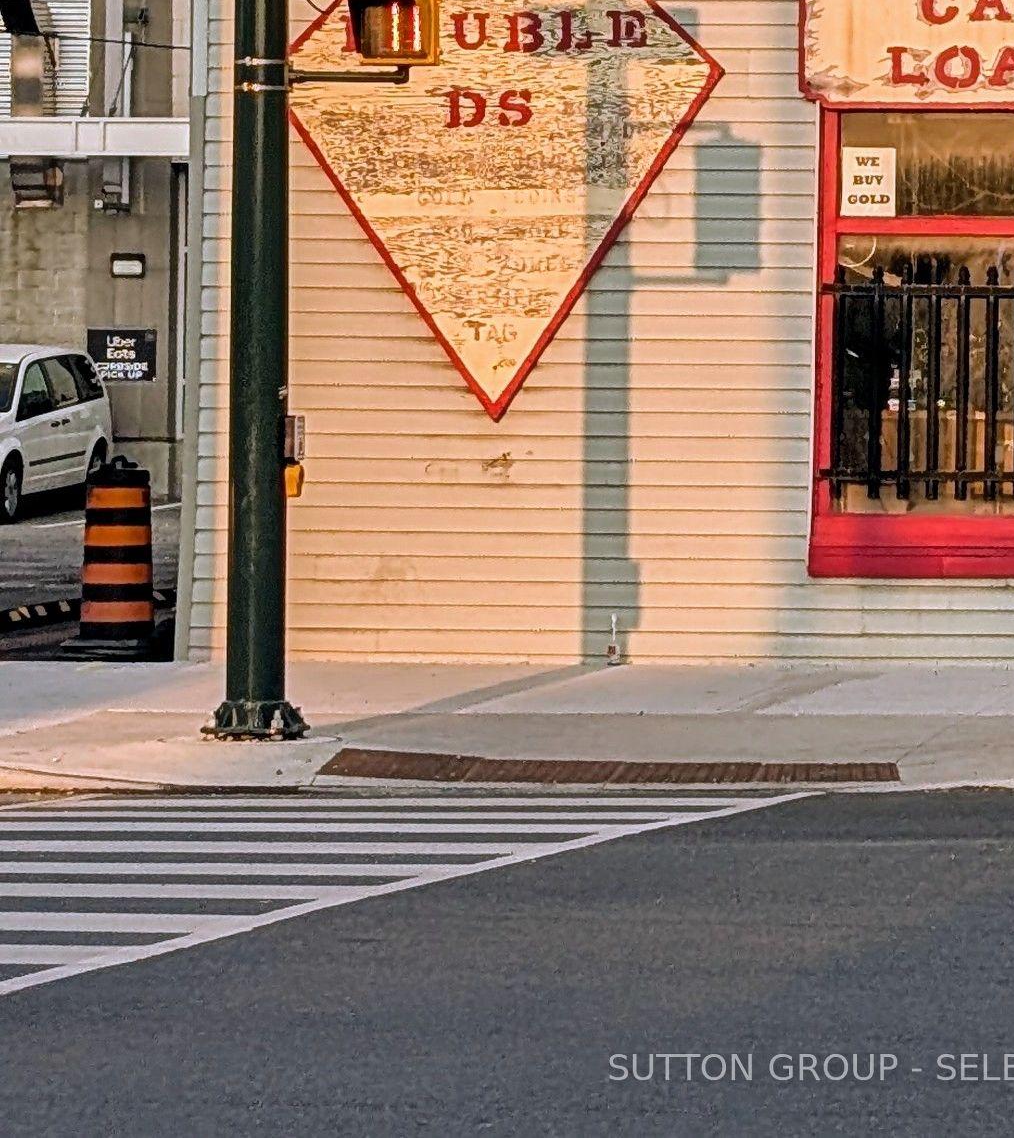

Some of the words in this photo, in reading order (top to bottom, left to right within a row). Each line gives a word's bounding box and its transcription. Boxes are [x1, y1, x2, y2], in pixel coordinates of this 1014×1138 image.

[341, 10, 647, 53] UBLE
[855, 156, 880, 167] WE
[852, 174, 883, 185] BUY
[847, 194, 890, 205] GOLD
[106, 334, 136, 348] Uber
[127, 370, 143, 379] UP
